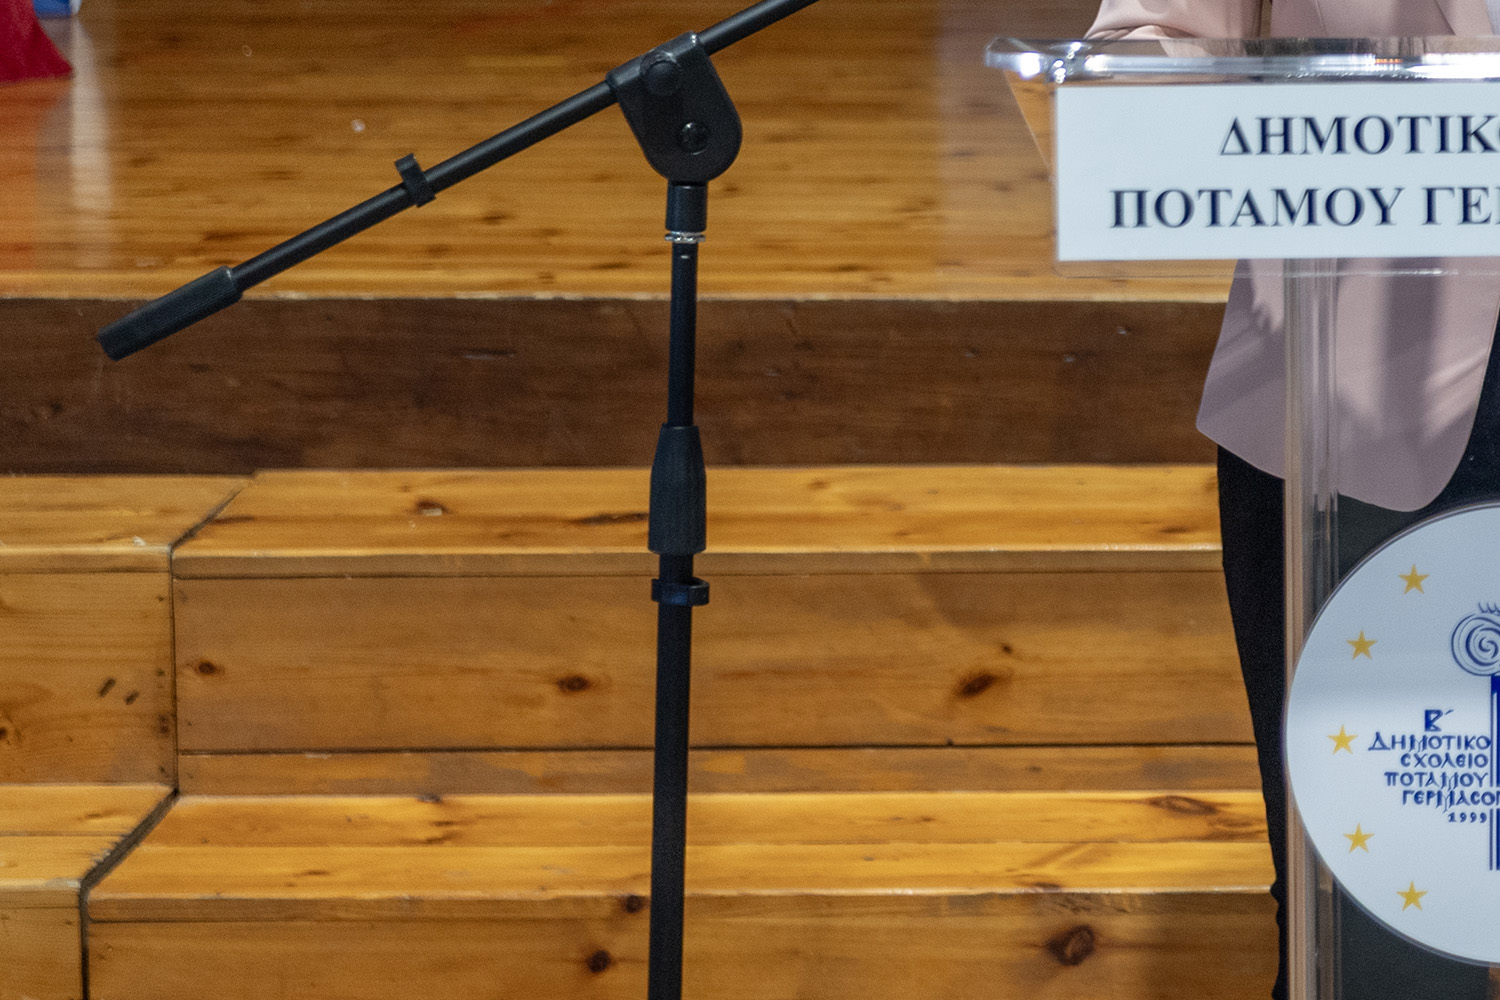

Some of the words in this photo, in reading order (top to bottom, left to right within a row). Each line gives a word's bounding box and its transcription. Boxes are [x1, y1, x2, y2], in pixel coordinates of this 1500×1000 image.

[1110, 186, 1404, 229] ΠΟΤΑΜΟΥ
[1367, 731, 1492, 752] ΔΗΜΟΤΙΚΟ
[1383, 771, 1489, 791] ΠΟΤΑΜΟΥ
[1447, 812, 1488, 823] 1999
